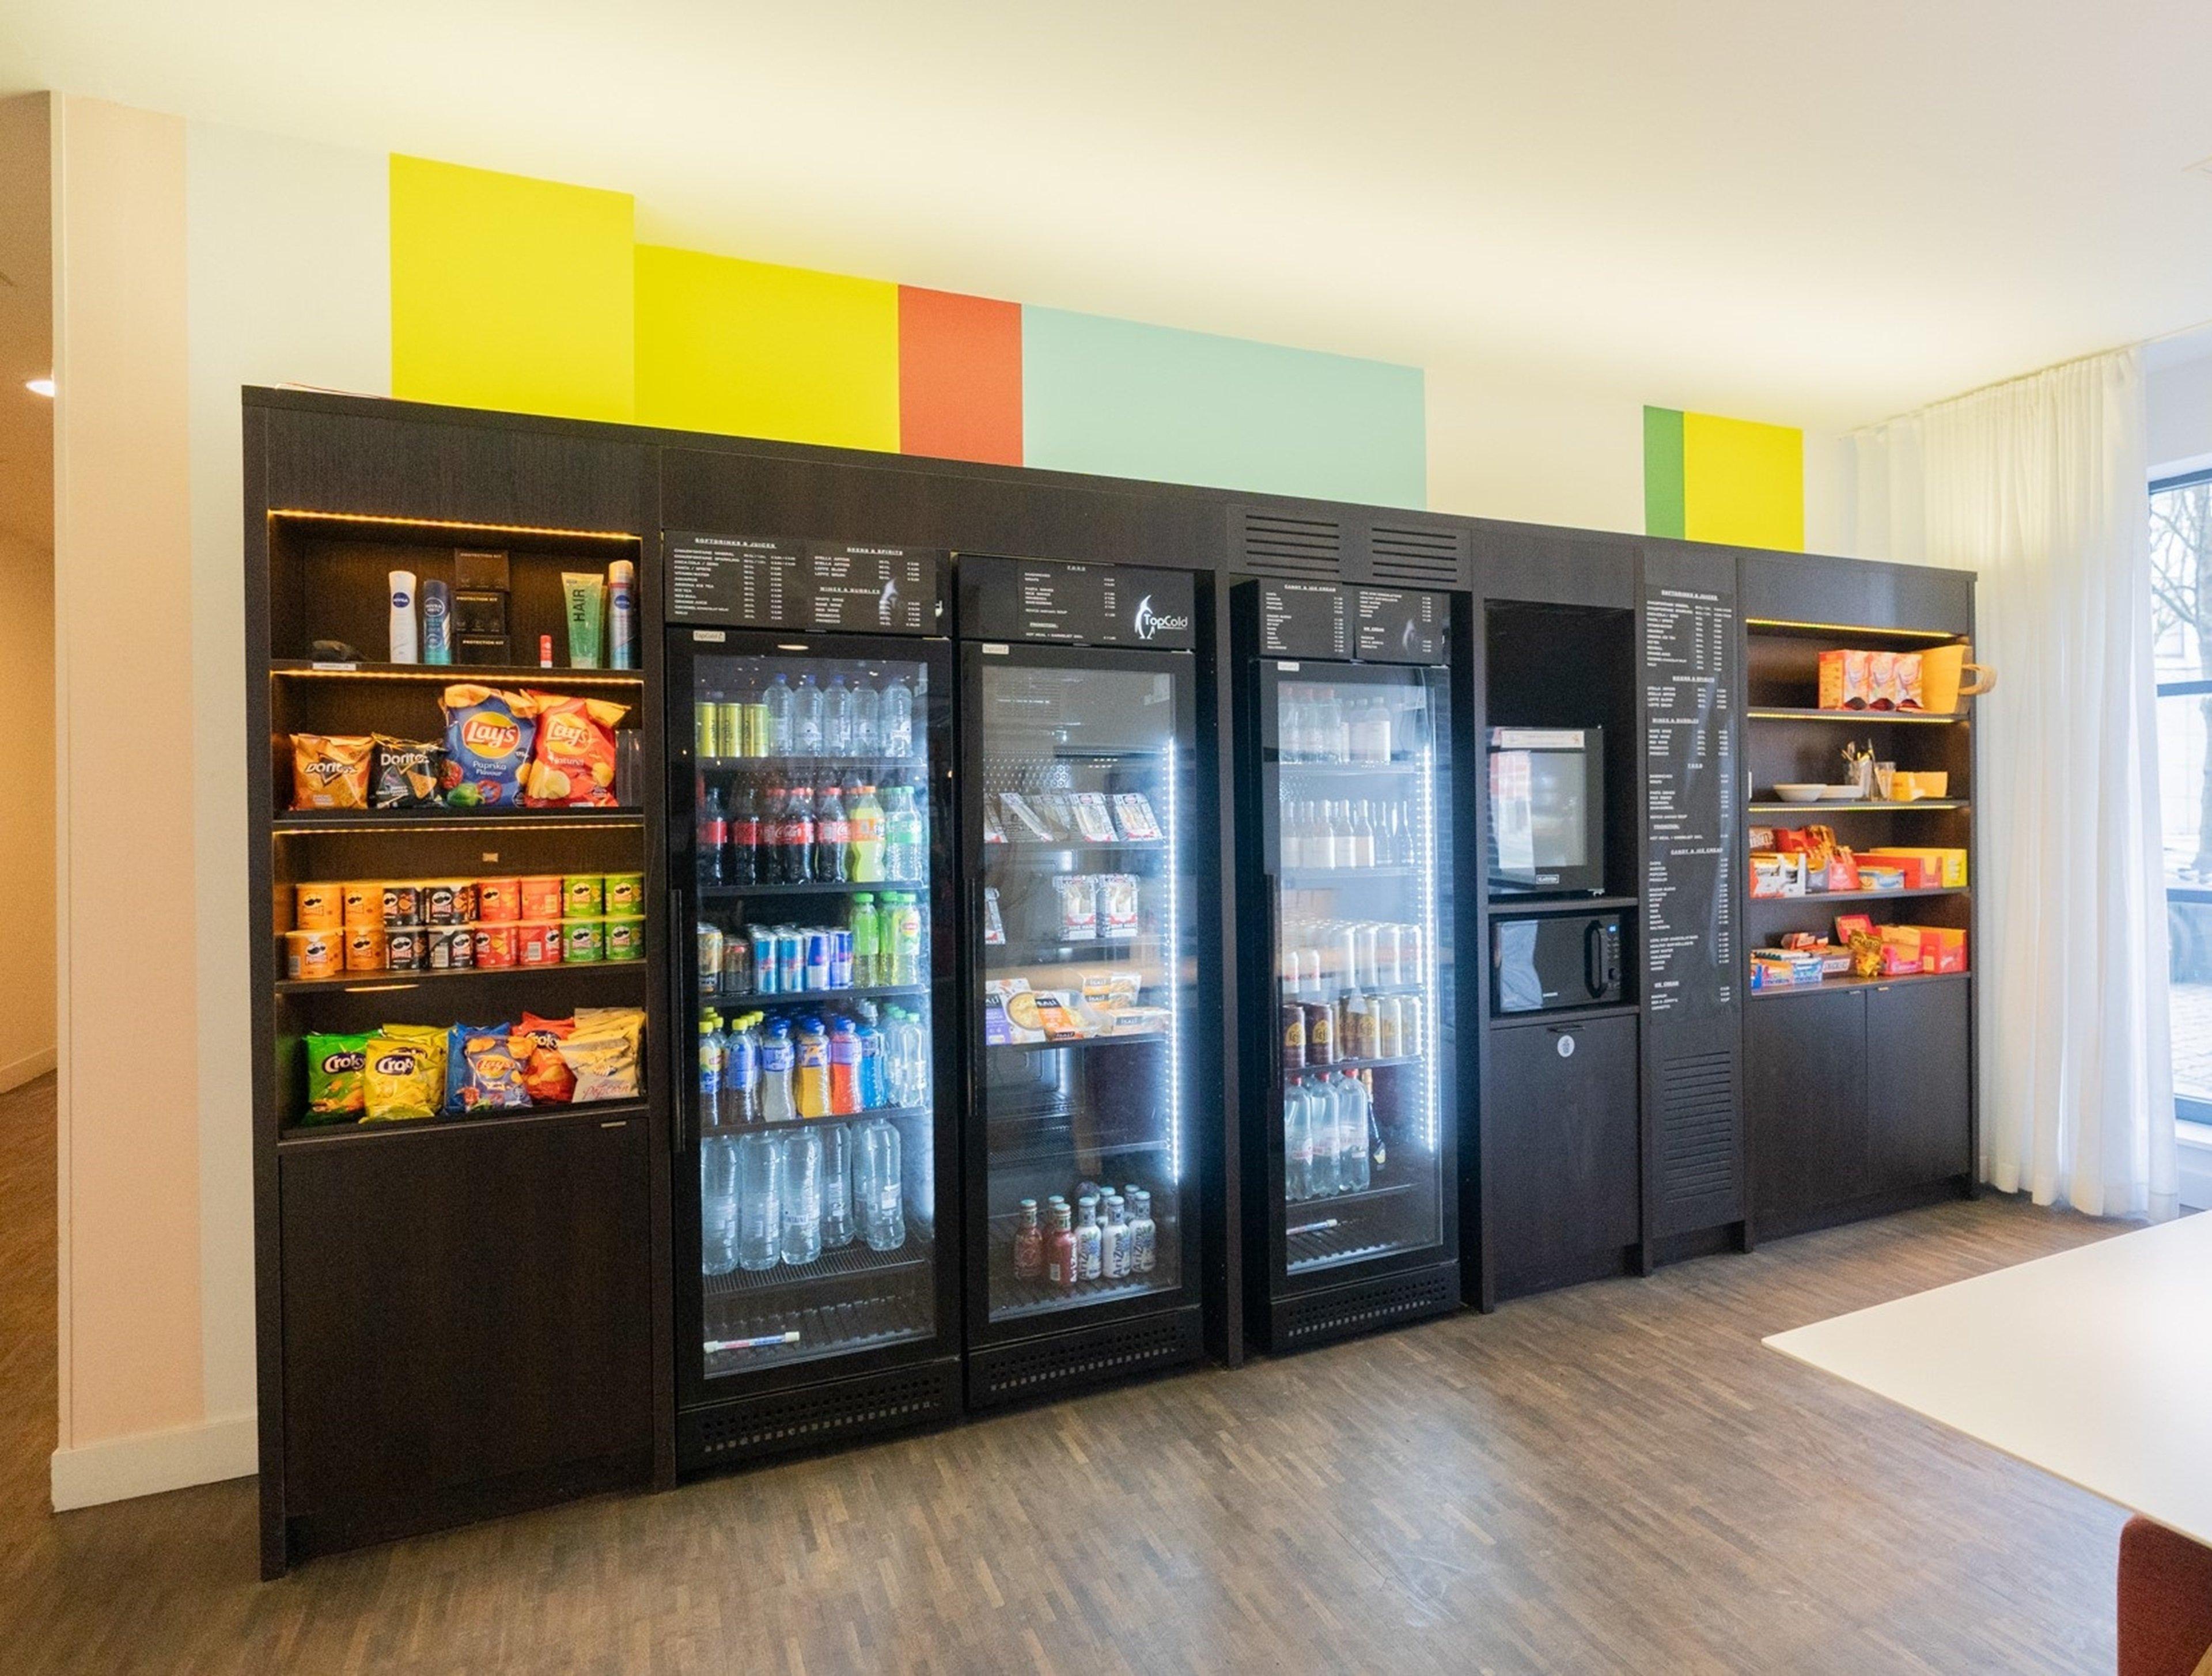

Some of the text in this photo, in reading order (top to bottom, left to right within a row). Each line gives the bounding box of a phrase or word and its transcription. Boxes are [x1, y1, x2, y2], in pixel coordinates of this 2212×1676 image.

[572, 589, 585, 621] HAIR
[1143, 613, 1188, 629] TopCold
[473, 760, 506, 772] Paprika
